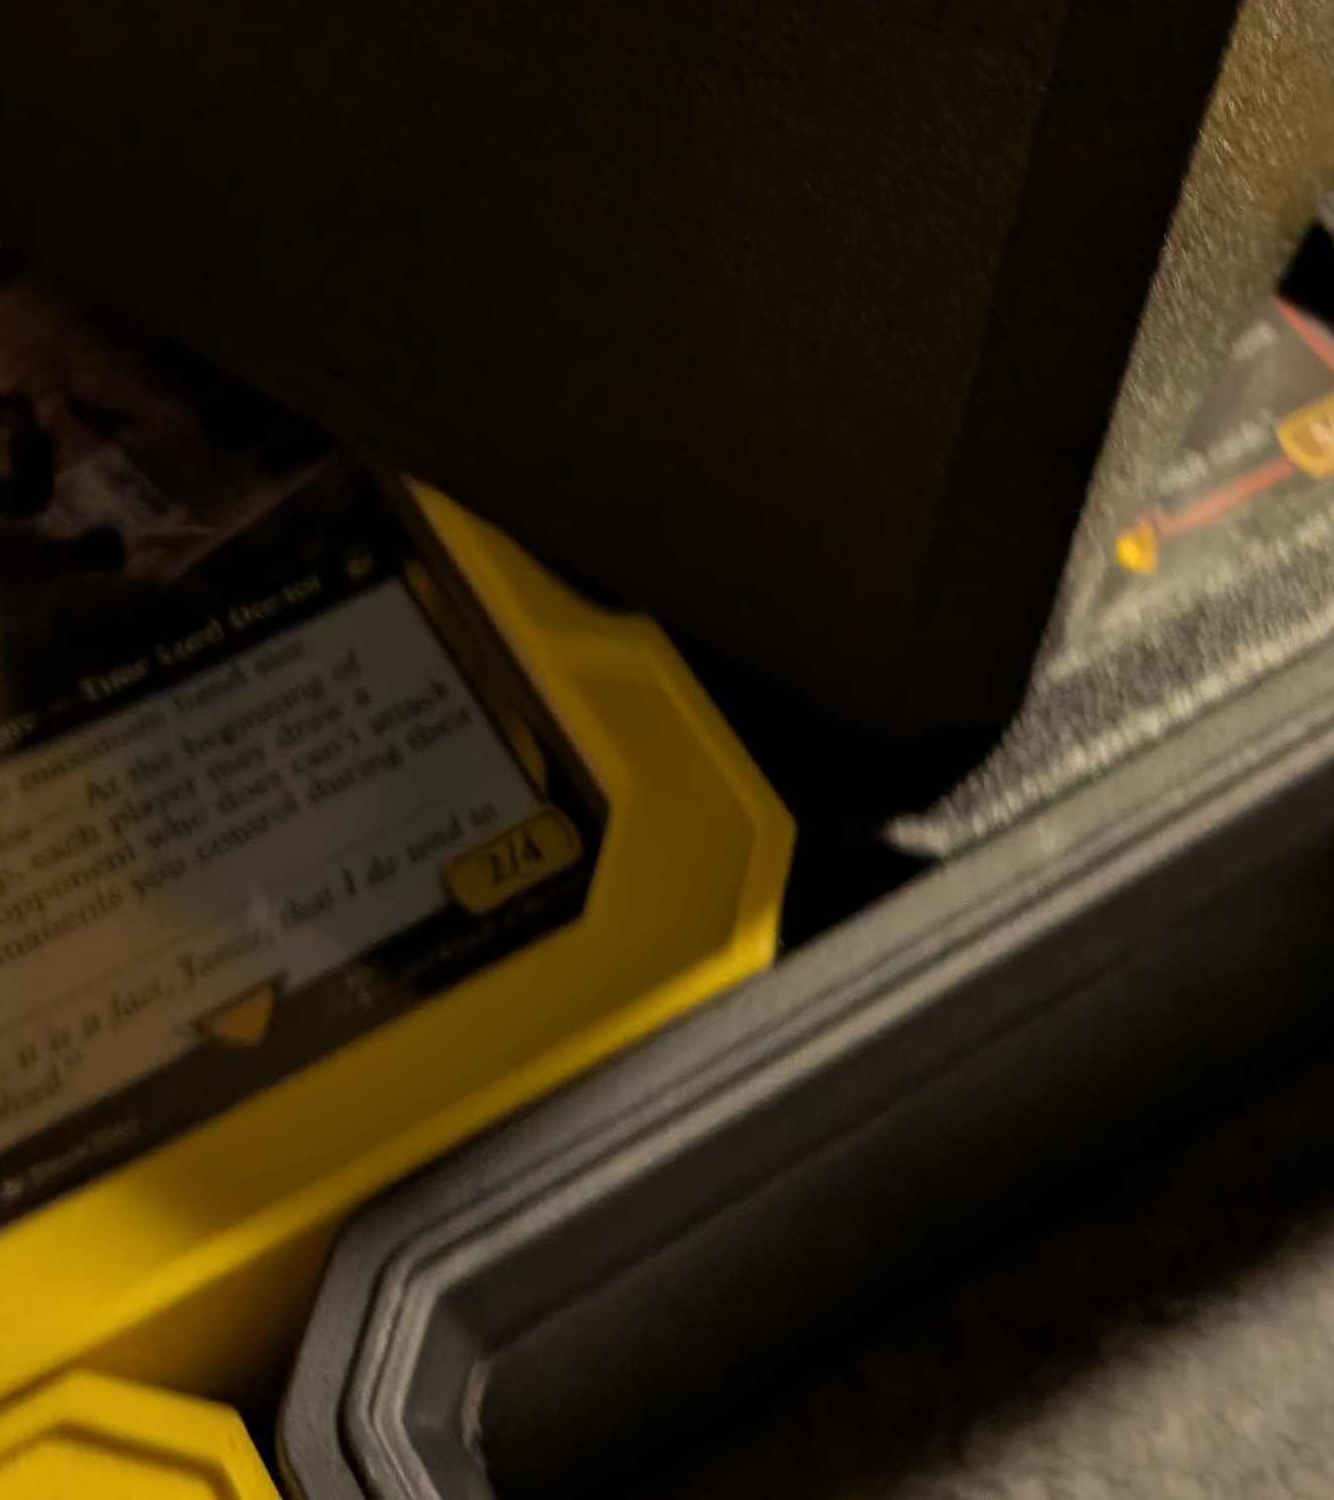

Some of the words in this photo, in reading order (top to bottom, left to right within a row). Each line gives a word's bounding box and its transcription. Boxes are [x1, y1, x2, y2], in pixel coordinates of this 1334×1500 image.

[76, 651, 156, 705] Time
[151, 617, 228, 668] Lord
[225, 572, 326, 632] Doctor
[167, 659, 249, 713] hand
[23, 818, 103, 872] each
[102, 772, 203, 837] player
[201, 740, 271, 786] may
[269, 700, 347, 750] draw
[346, 685, 375, 711] a
[79, 773, 126, 811] At
[123, 745, 178, 787] the
[175, 673, 332, 763] beginning
[322, 647, 369, 687] of
[141, 803, 217, 855] who
[211, 765, 288, 816] does
[283, 725, 366, 778] can't
[359, 675, 456, 736] attack
[125, 851, 194, 902] you
[187, 789, 306, 862] control
[297, 738, 408, 808] during
[473, 828, 550, 886] 2/4
[97, 966, 182, 1030] fact,
[271, 879, 341, 932] that
[358, 850, 407, 889] do
[396, 814, 470, 866] tend
[464, 799, 505, 832] to
